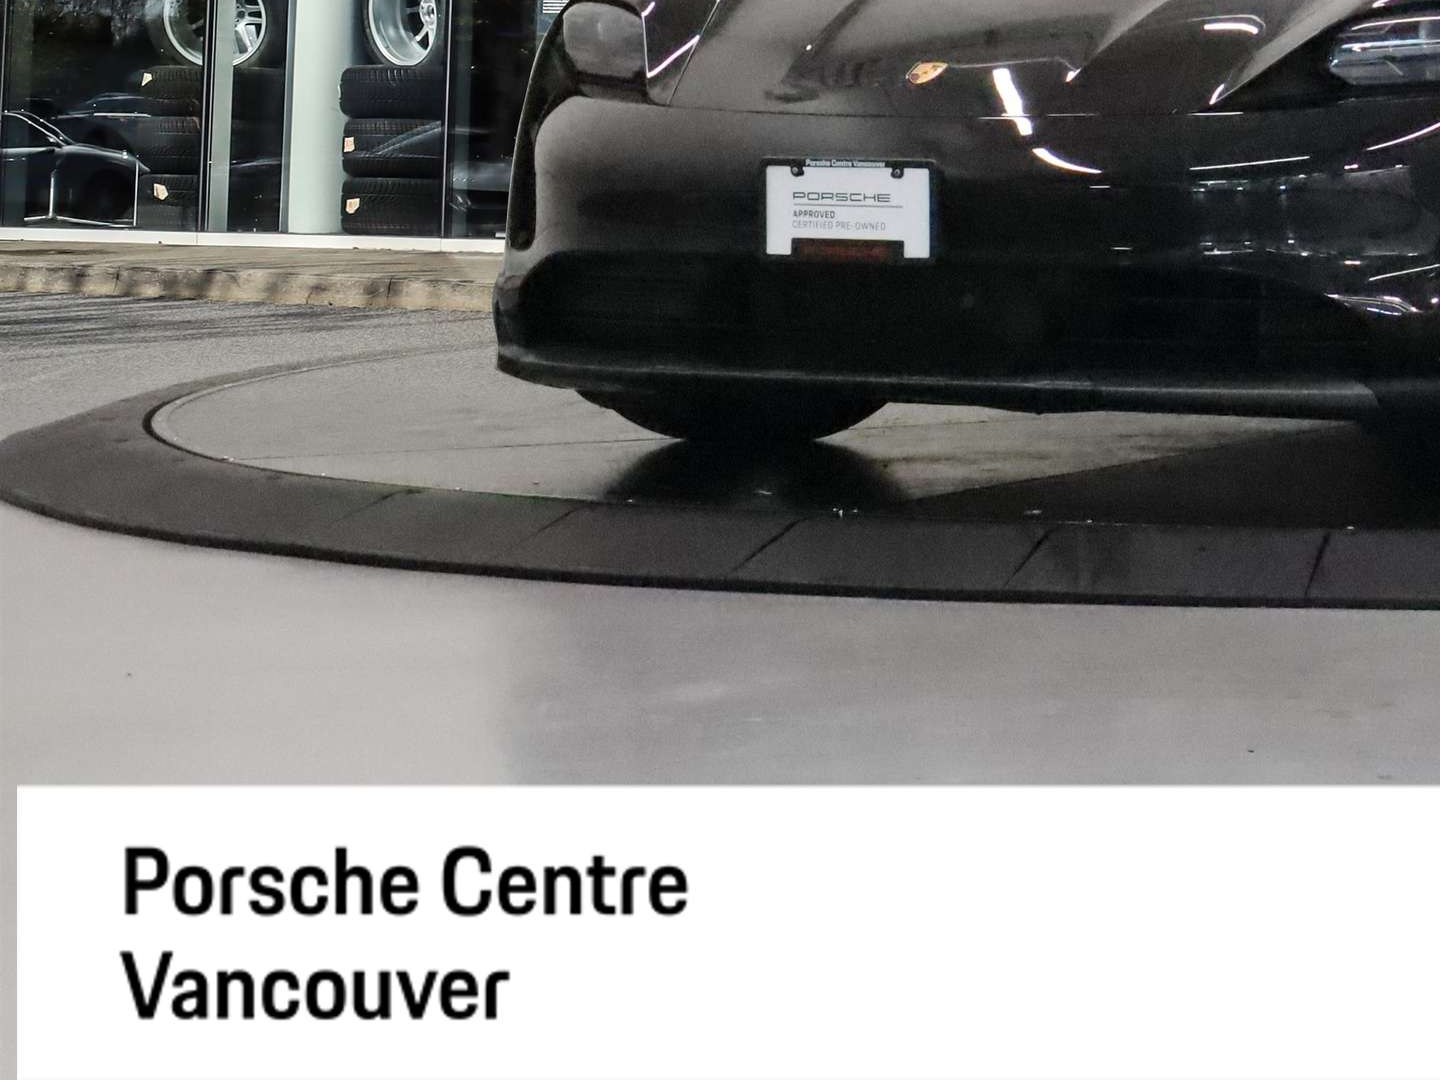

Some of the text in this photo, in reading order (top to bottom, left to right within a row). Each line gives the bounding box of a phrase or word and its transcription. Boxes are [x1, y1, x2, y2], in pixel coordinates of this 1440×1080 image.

[792, 191, 891, 203] PORSCHE
[793, 209, 836, 219] APPROVED
[792, 220, 886, 232] CERTIFIED PRE-OWNED
